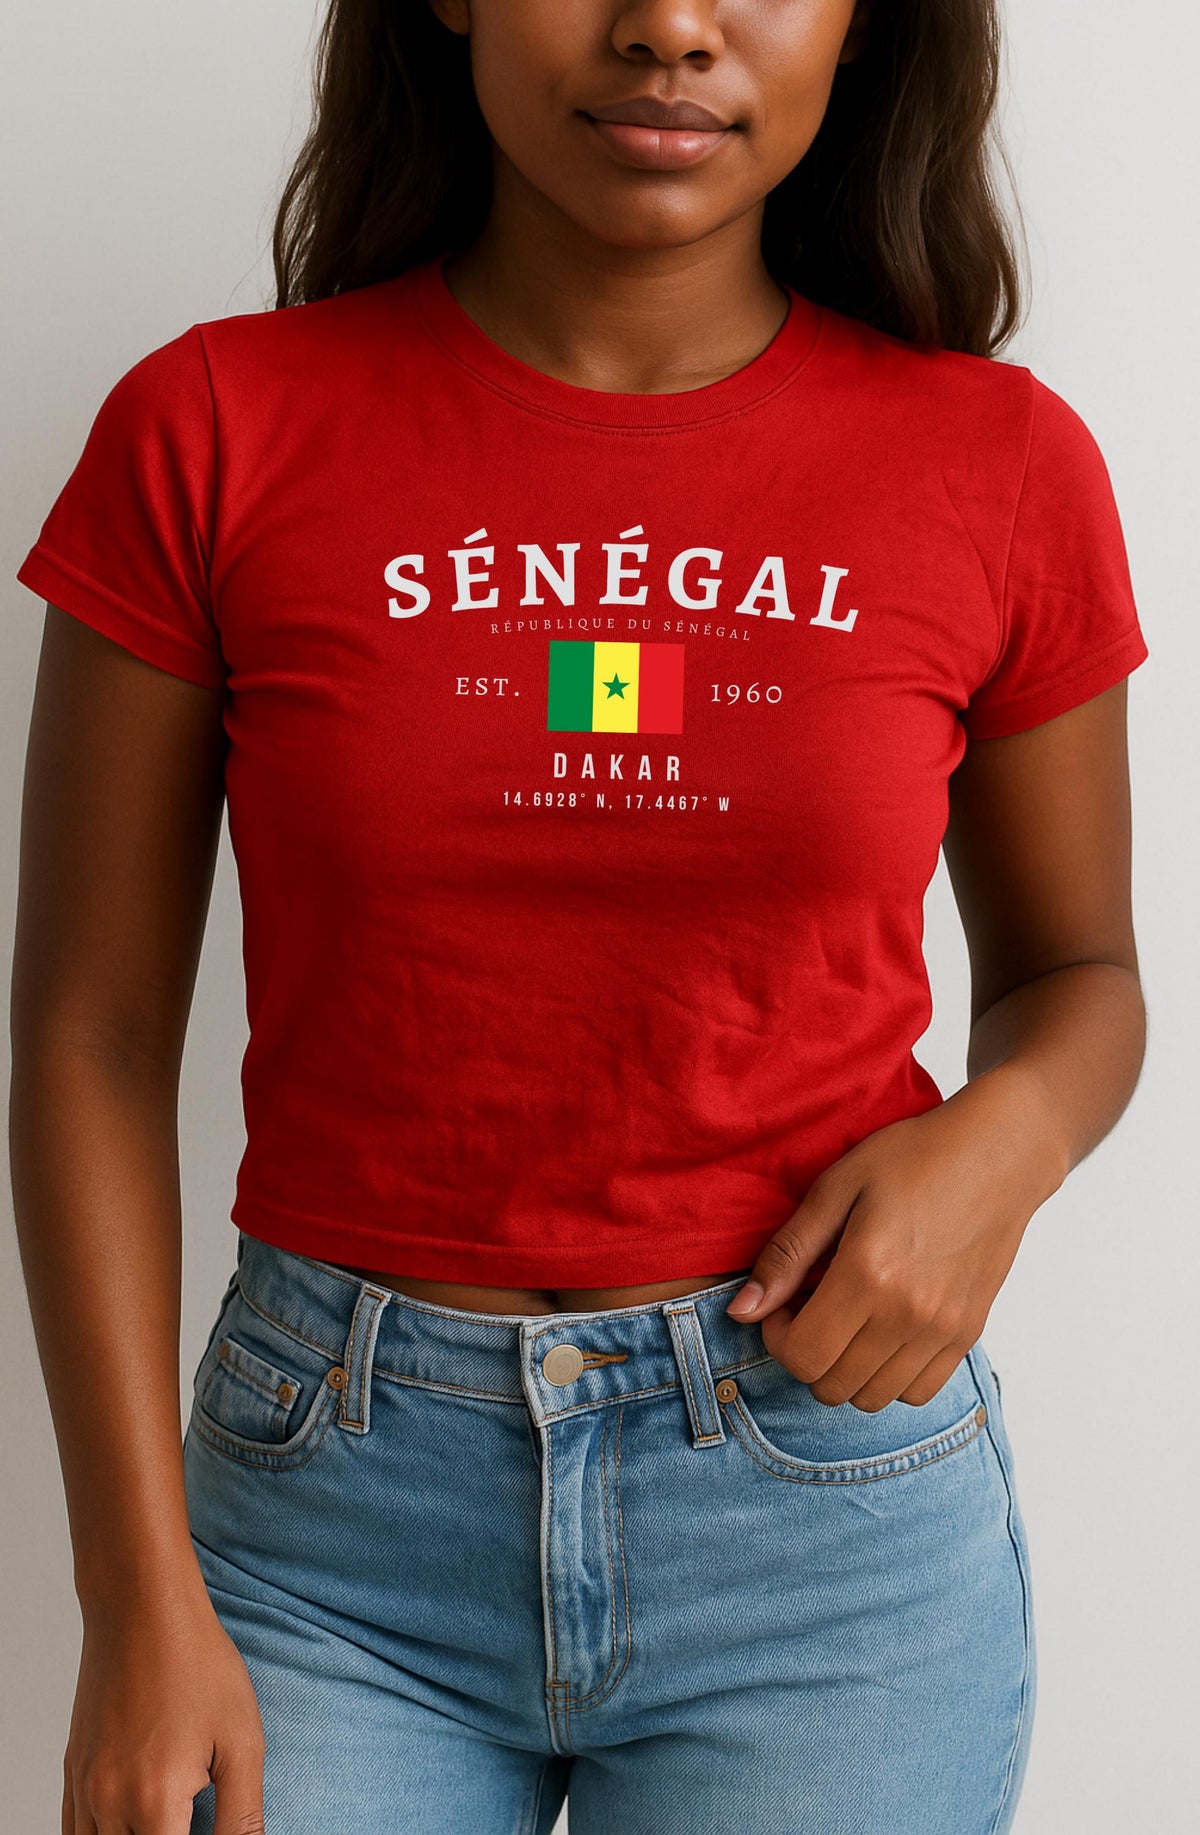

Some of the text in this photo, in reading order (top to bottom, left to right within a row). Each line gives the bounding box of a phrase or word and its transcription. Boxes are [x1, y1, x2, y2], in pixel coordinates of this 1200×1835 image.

[383, 524, 859, 633] SÉNÉGAL
[490, 618, 752, 641] RÉPUBLIQUE DU SÉNÉGAL
[455, 677, 783, 706] EST. 1960
[553, 752, 681, 781] DAKAR
[503, 791, 730, 812] 14.6928° N, 17.4467° W
